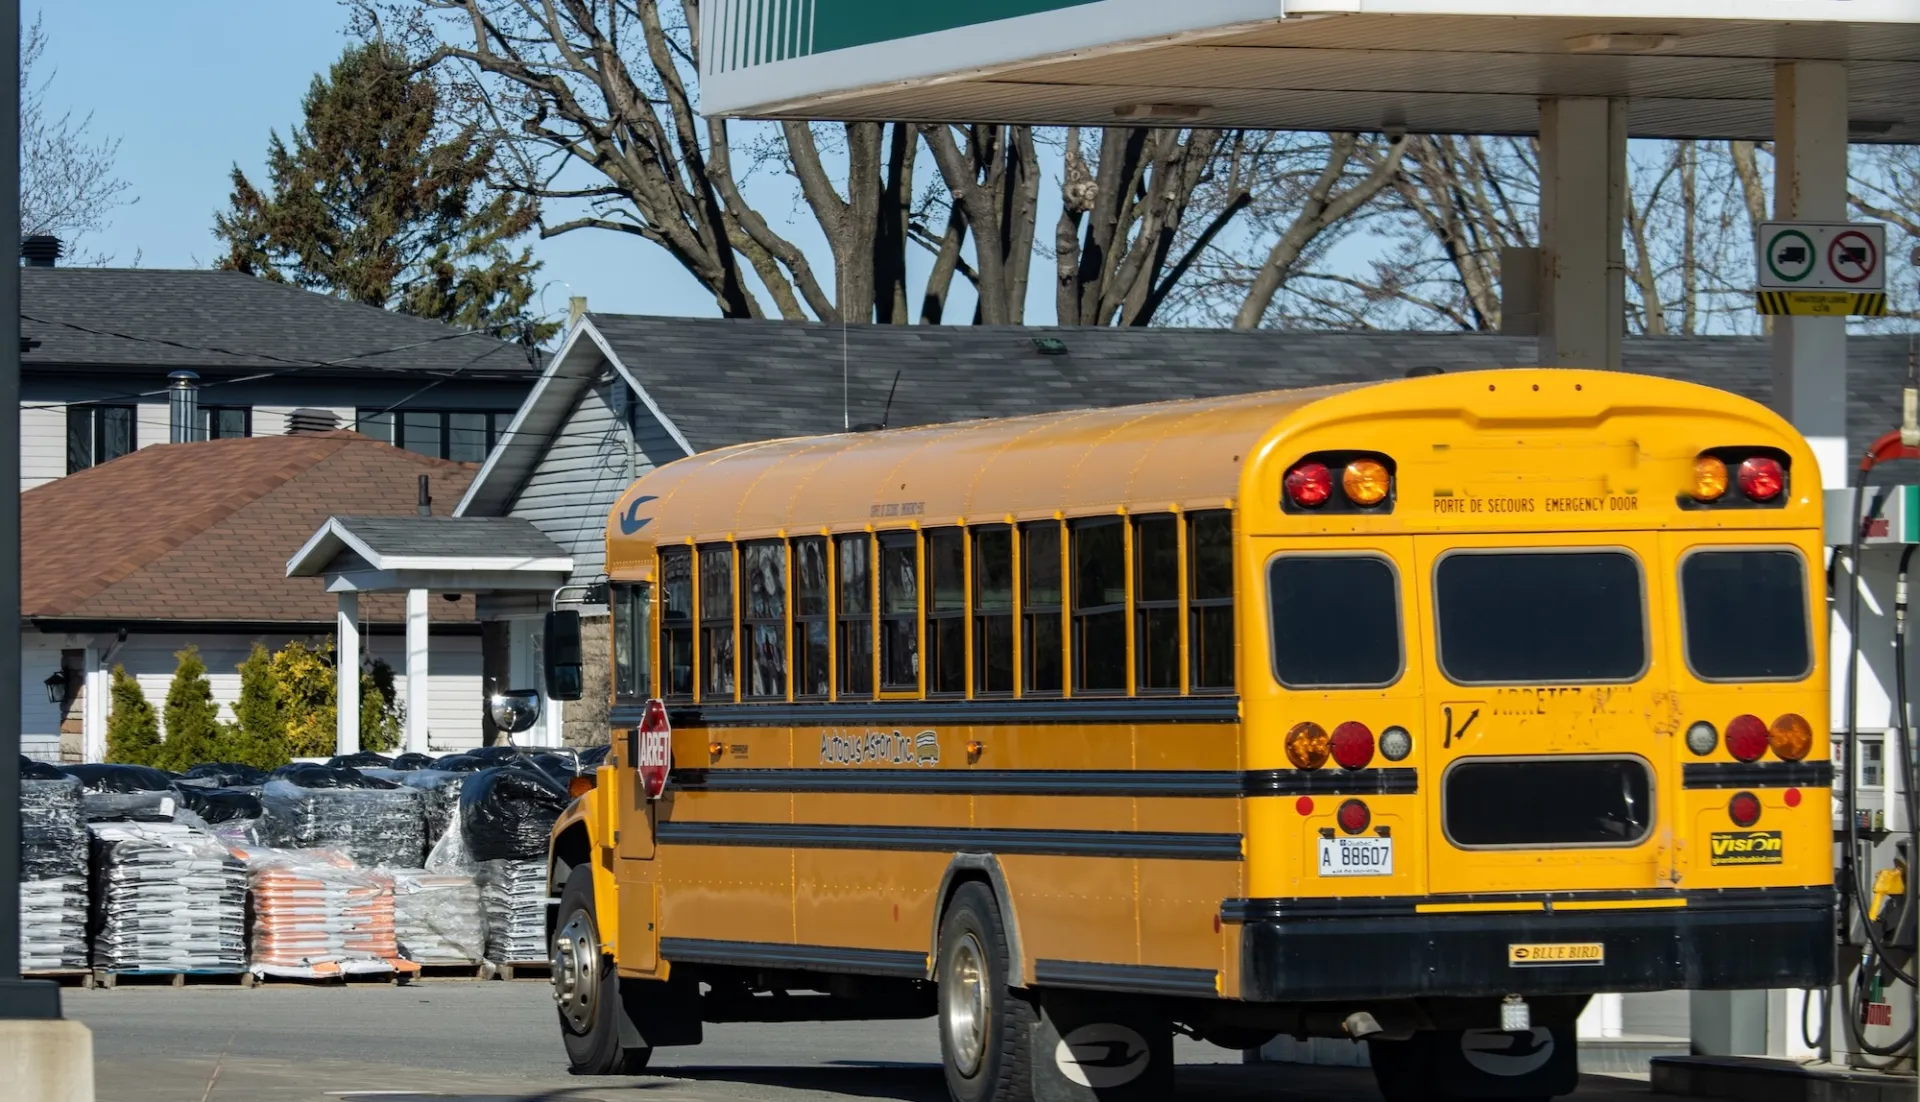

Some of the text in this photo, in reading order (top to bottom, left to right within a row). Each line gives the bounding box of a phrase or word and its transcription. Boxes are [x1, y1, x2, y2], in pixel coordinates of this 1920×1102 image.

[1434, 496, 1638, 513] PORTE DE SECOURS EMERGENCY DOOR
[640, 732, 669, 766] ARRET
[1322, 847, 1389, 866] A 88607
[1532, 946, 1599, 959] BLUE BIRD
